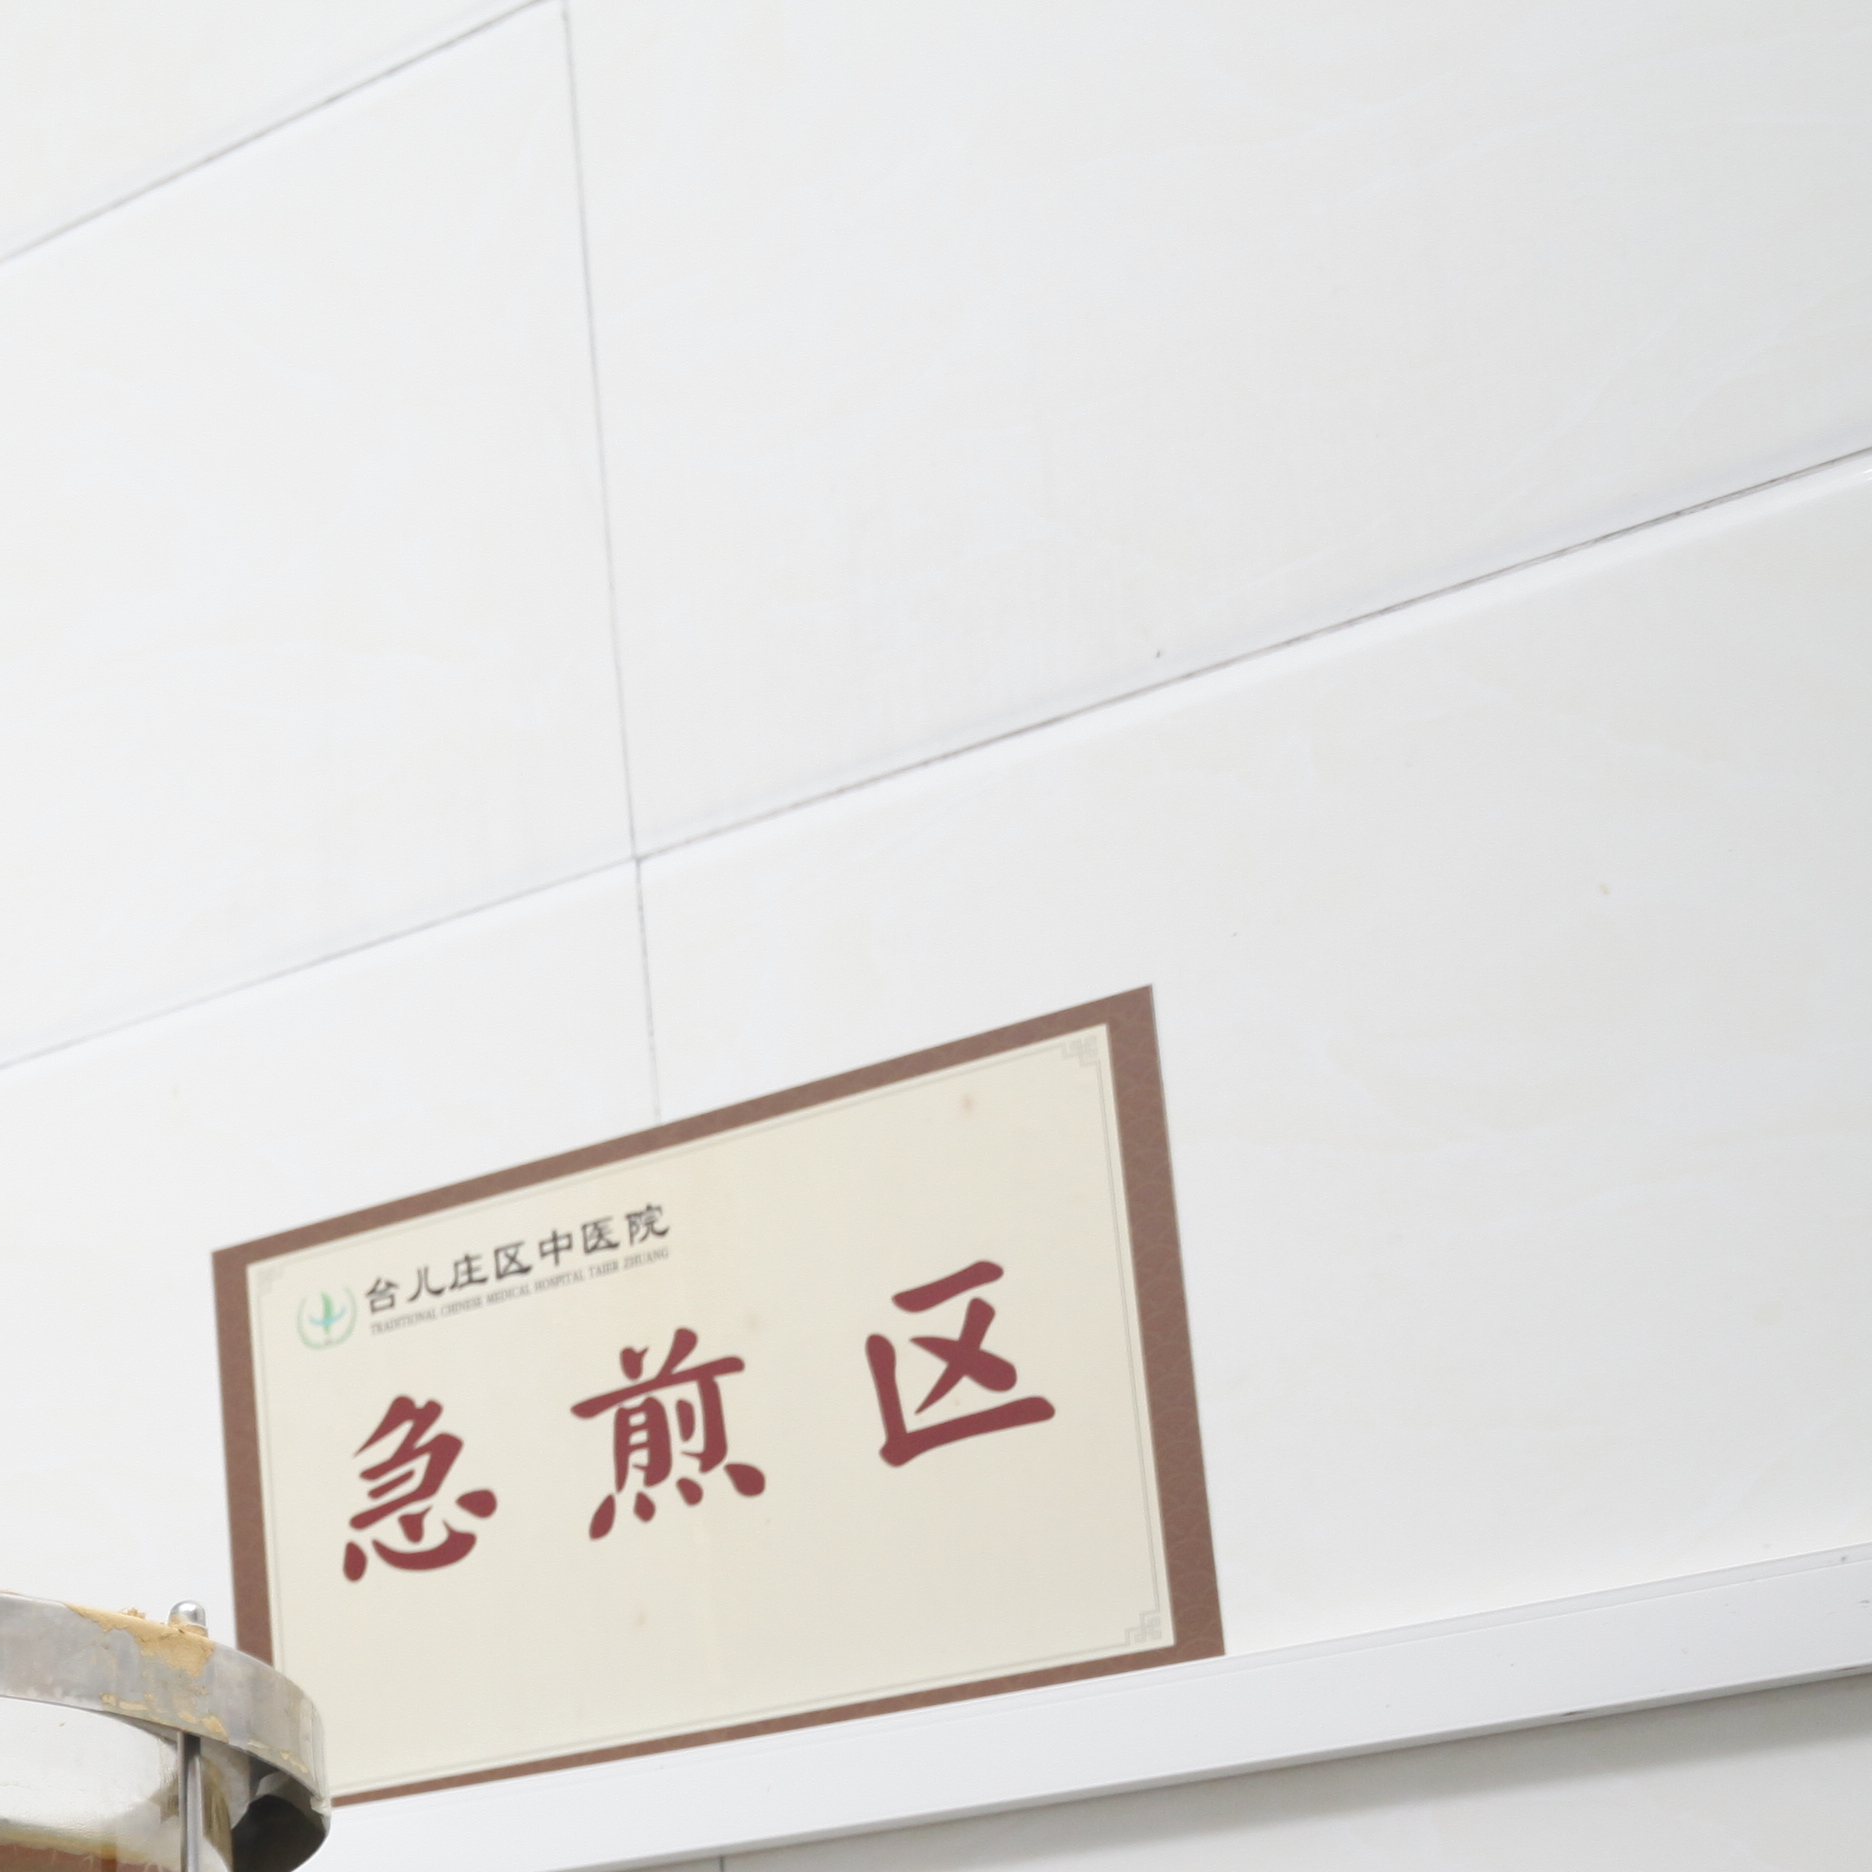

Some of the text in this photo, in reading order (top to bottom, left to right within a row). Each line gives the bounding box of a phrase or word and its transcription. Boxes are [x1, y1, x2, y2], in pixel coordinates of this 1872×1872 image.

[366, 1203, 670, 1315] 台儿庄区中医院
[371, 1248, 670, 1336] TRADITIONAL CHINESE MEDICAL HOSPITAL TAIER ZHUANG
[342, 1260, 1056, 1583] 急煎区
